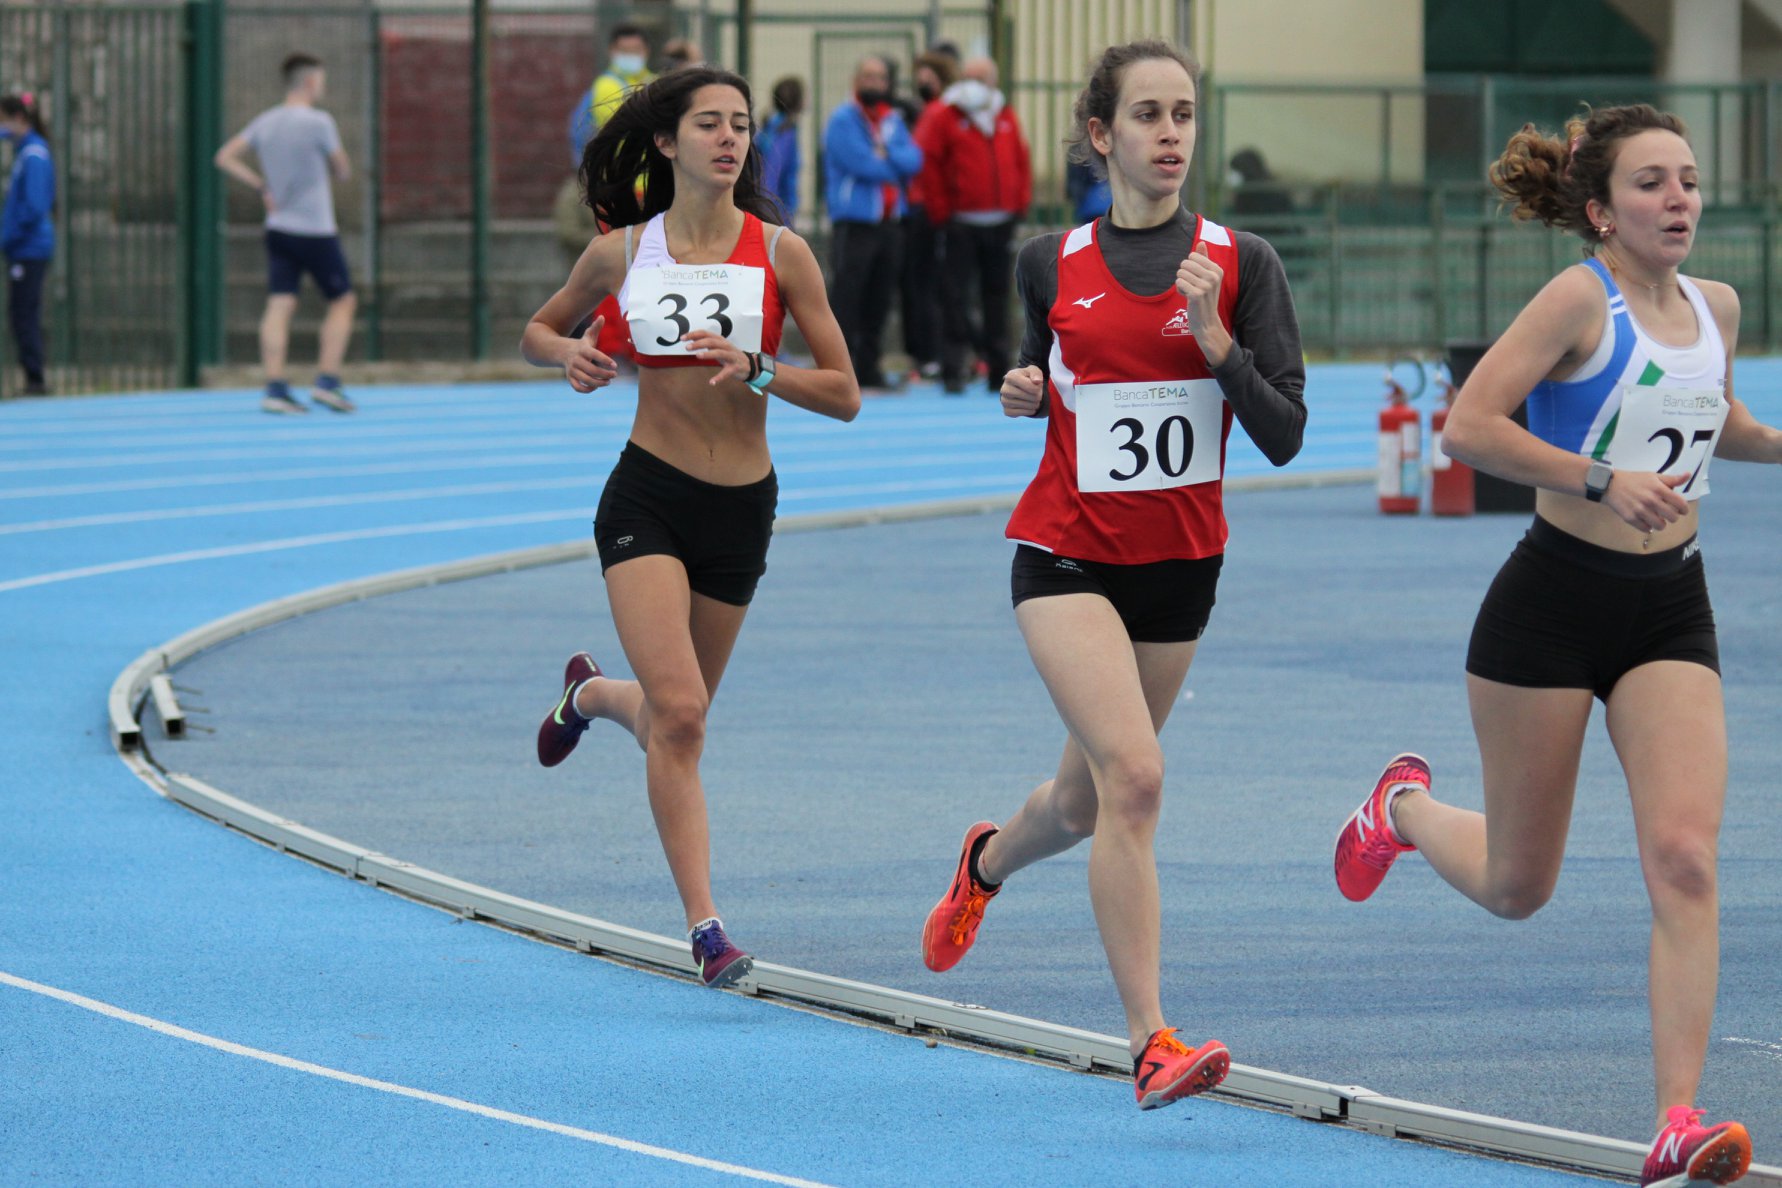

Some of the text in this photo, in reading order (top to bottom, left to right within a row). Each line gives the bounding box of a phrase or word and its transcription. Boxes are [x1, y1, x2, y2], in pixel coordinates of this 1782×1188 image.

[656, 292, 733, 347] 33
[1113, 386, 1189, 401] BancaTEMA
[1109, 415, 1194, 481] 30
[1647, 427, 1716, 493] 27
